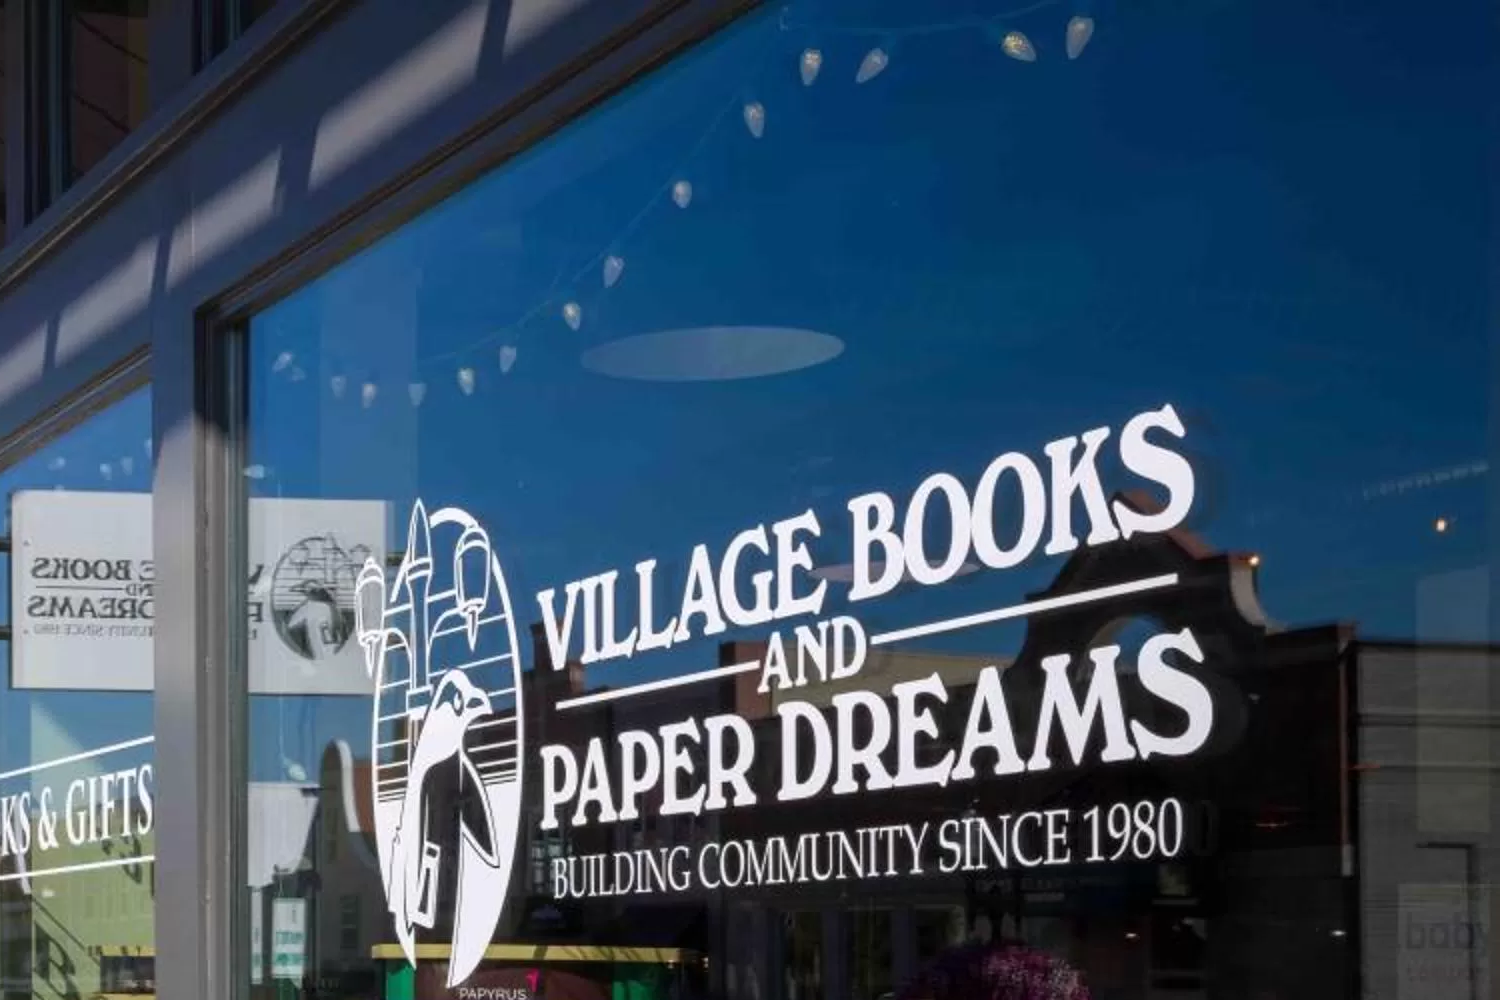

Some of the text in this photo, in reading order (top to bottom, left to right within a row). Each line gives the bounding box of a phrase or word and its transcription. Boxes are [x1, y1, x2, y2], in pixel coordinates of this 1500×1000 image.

[537, 403, 1195, 672] VILLAGE BOOKS
[757, 615, 867, 693] AND
[540, 627, 1213, 830] PAPER DREAMS
[37, 786, 58, 851] &
[65, 763, 155, 846] GIFTS
[553, 798, 1184, 899] BUILDING COMMUNITY SINCE 1980
[459, 987, 528, 1000] PAPYRUS
